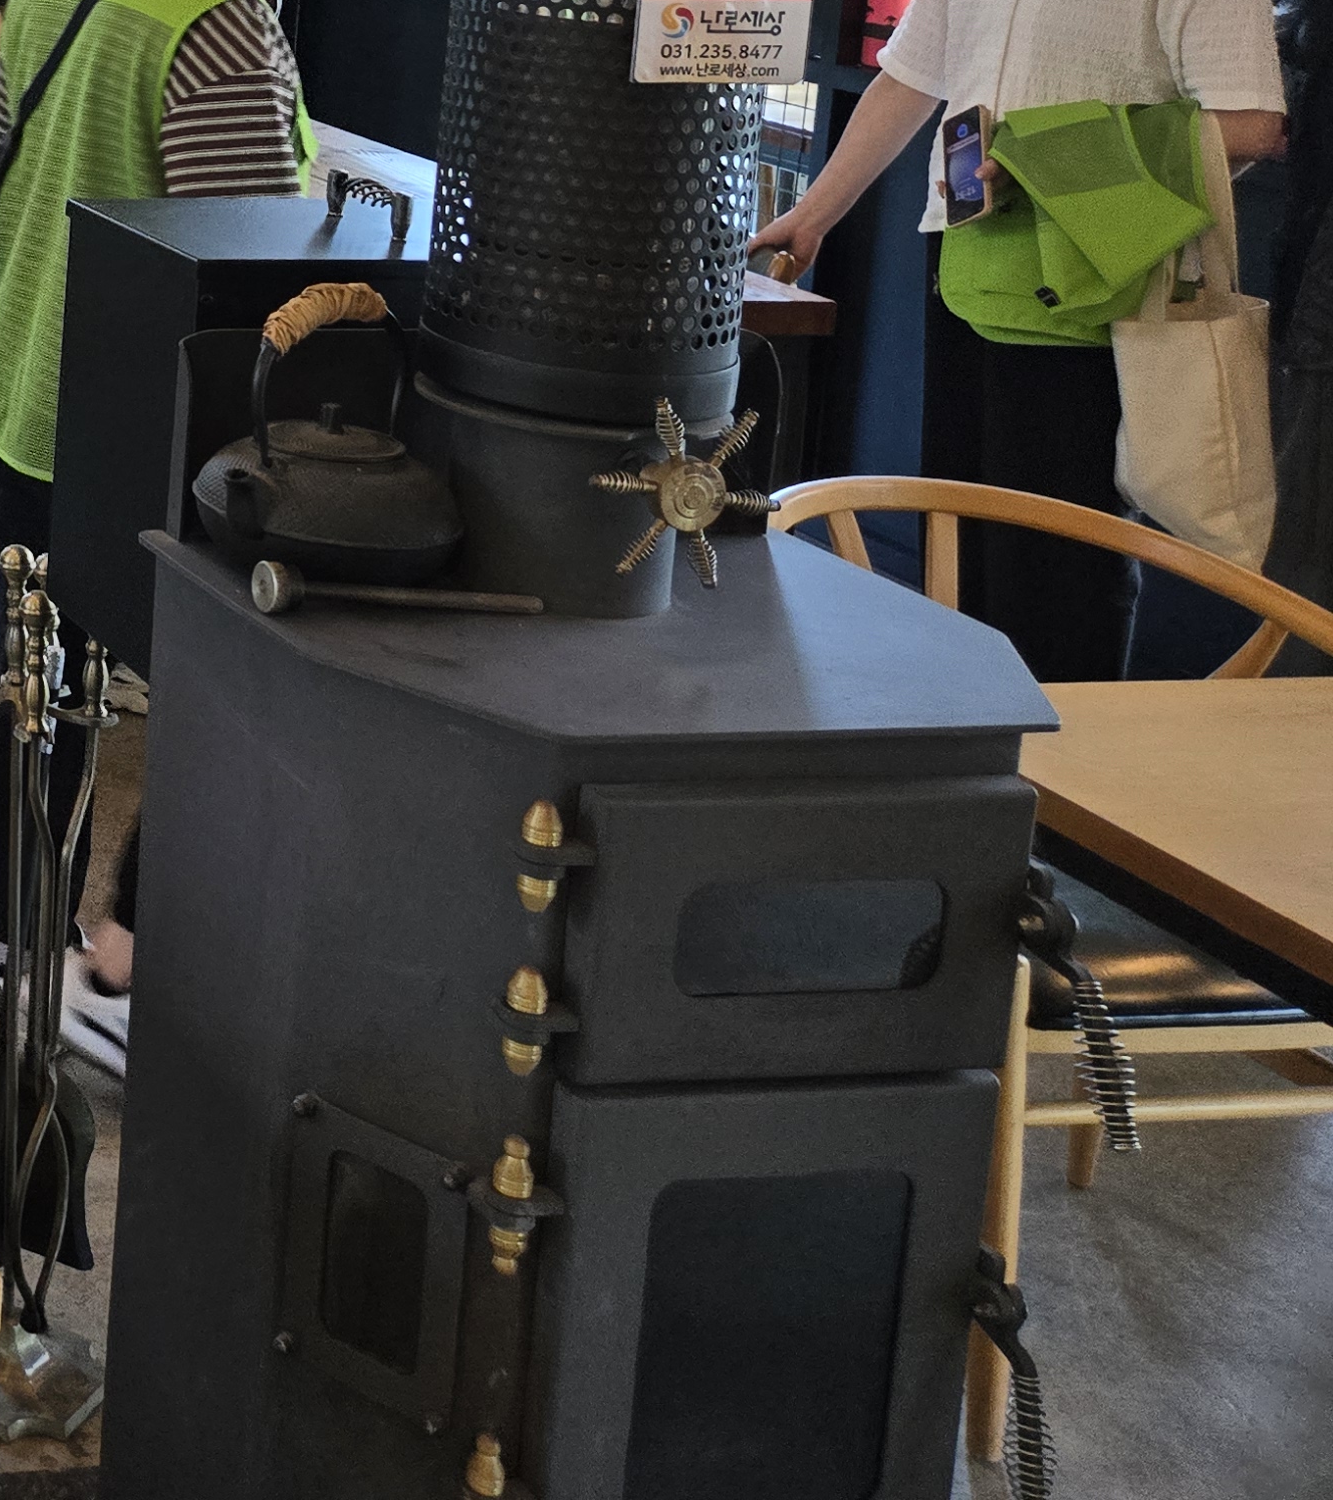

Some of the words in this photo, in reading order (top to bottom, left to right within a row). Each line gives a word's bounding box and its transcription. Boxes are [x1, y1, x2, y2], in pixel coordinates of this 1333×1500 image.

[700, 10, 786, 36] 난로세상
[660, 43, 783, 60] 031.235.8477
[659, 63, 780, 78] www.난로세상.com
